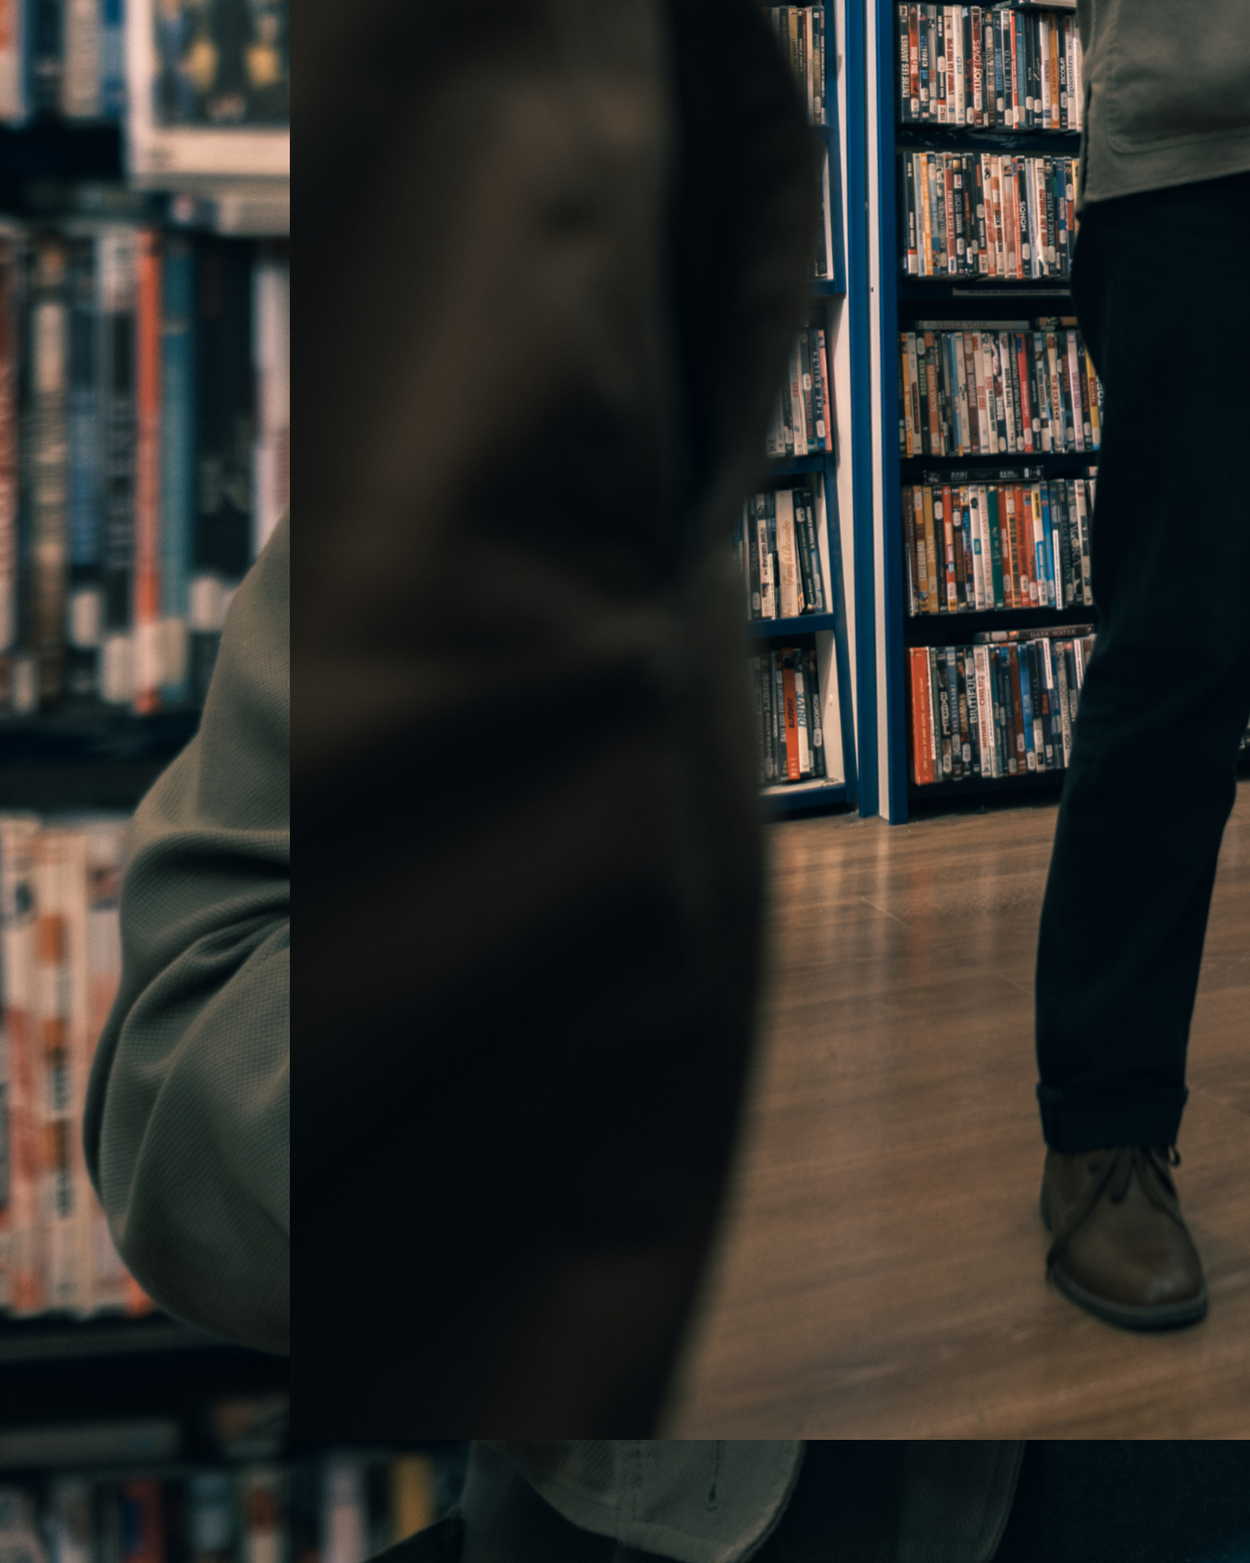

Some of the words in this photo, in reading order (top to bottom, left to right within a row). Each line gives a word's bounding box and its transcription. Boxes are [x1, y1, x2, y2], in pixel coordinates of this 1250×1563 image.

[901, 35, 910, 63] JAMBES
[920, 35, 929, 68] cielito
[972, 39, 982, 66] LOVES
[902, 77, 910, 98] ENTRE
[974, 67, 983, 96] ELLIOT
[1067, 55, 1075, 99] Epicentro
[1019, 200, 1028, 232] MONOS
[1039, 189, 1047, 217] JOSELITO
[813, 350, 822, 388] GUILTY
[918, 358, 928, 396] REDEEMER
[928, 365, 937, 390] PRIETO
[1003, 367, 1011, 389] Brûlée
[928, 390, 938, 413] SILVIA
[967, 379, 977, 408] NOMBRE
[996, 396, 1005, 421] ROUND
[981, 504, 990, 535] HABITO
[780, 519, 793, 556] Alexandre
[926, 534, 936, 563] julieta
[1060, 514, 1072, 584] REGRESSION
[750, 542, 758, 571] SERENA
[782, 562, 795, 587] Fanny
[1029, 630, 1050, 638] DARK
[1051, 628, 1076, 636] WATER
[763, 672, 771, 711] LIDICE
[950, 684, 958, 721] REVENANT
[966, 674, 979, 724] BIUTIFUL
[1060, 681, 1070, 730] HOLLYWOOD
[795, 691, 808, 728] DRIVE
[812, 693, 821, 728] BRONSON
[980, 719, 988, 748] MOTHER
